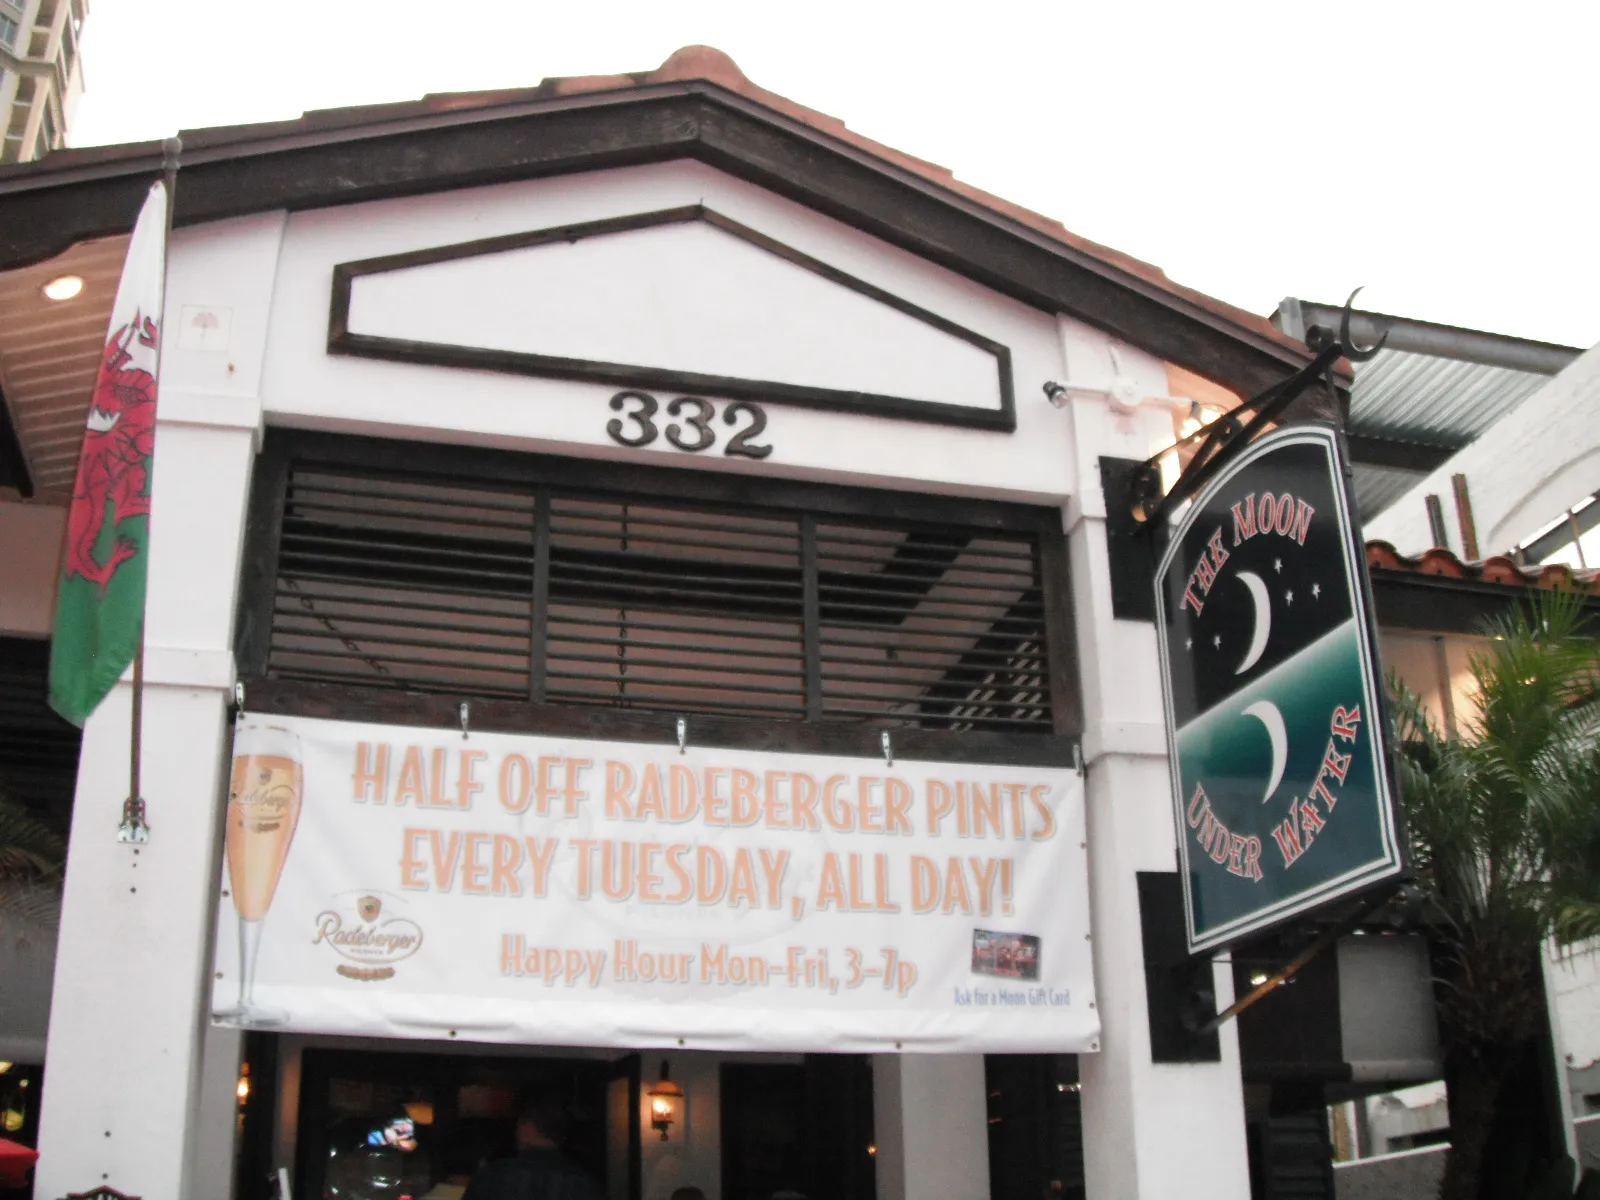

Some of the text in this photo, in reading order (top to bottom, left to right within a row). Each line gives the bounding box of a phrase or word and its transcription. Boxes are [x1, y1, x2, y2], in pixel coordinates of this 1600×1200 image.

[606, 391, 773, 460] 332
[1180, 491, 1316, 617] THE MOON
[352, 741, 1058, 840] HALF OFF RADEBERGER PINTS
[1185, 703, 1361, 884] UNDER WATER
[399, 828, 1016, 920] EVERY TUESDAY, ALL DAY!
[312, 910, 419, 957] Radeberger
[500, 934, 606, 989] Happy
[613, 940, 695, 983] Hour
[954, 987, 1070, 1006] Ask for a Moon Gift Card
